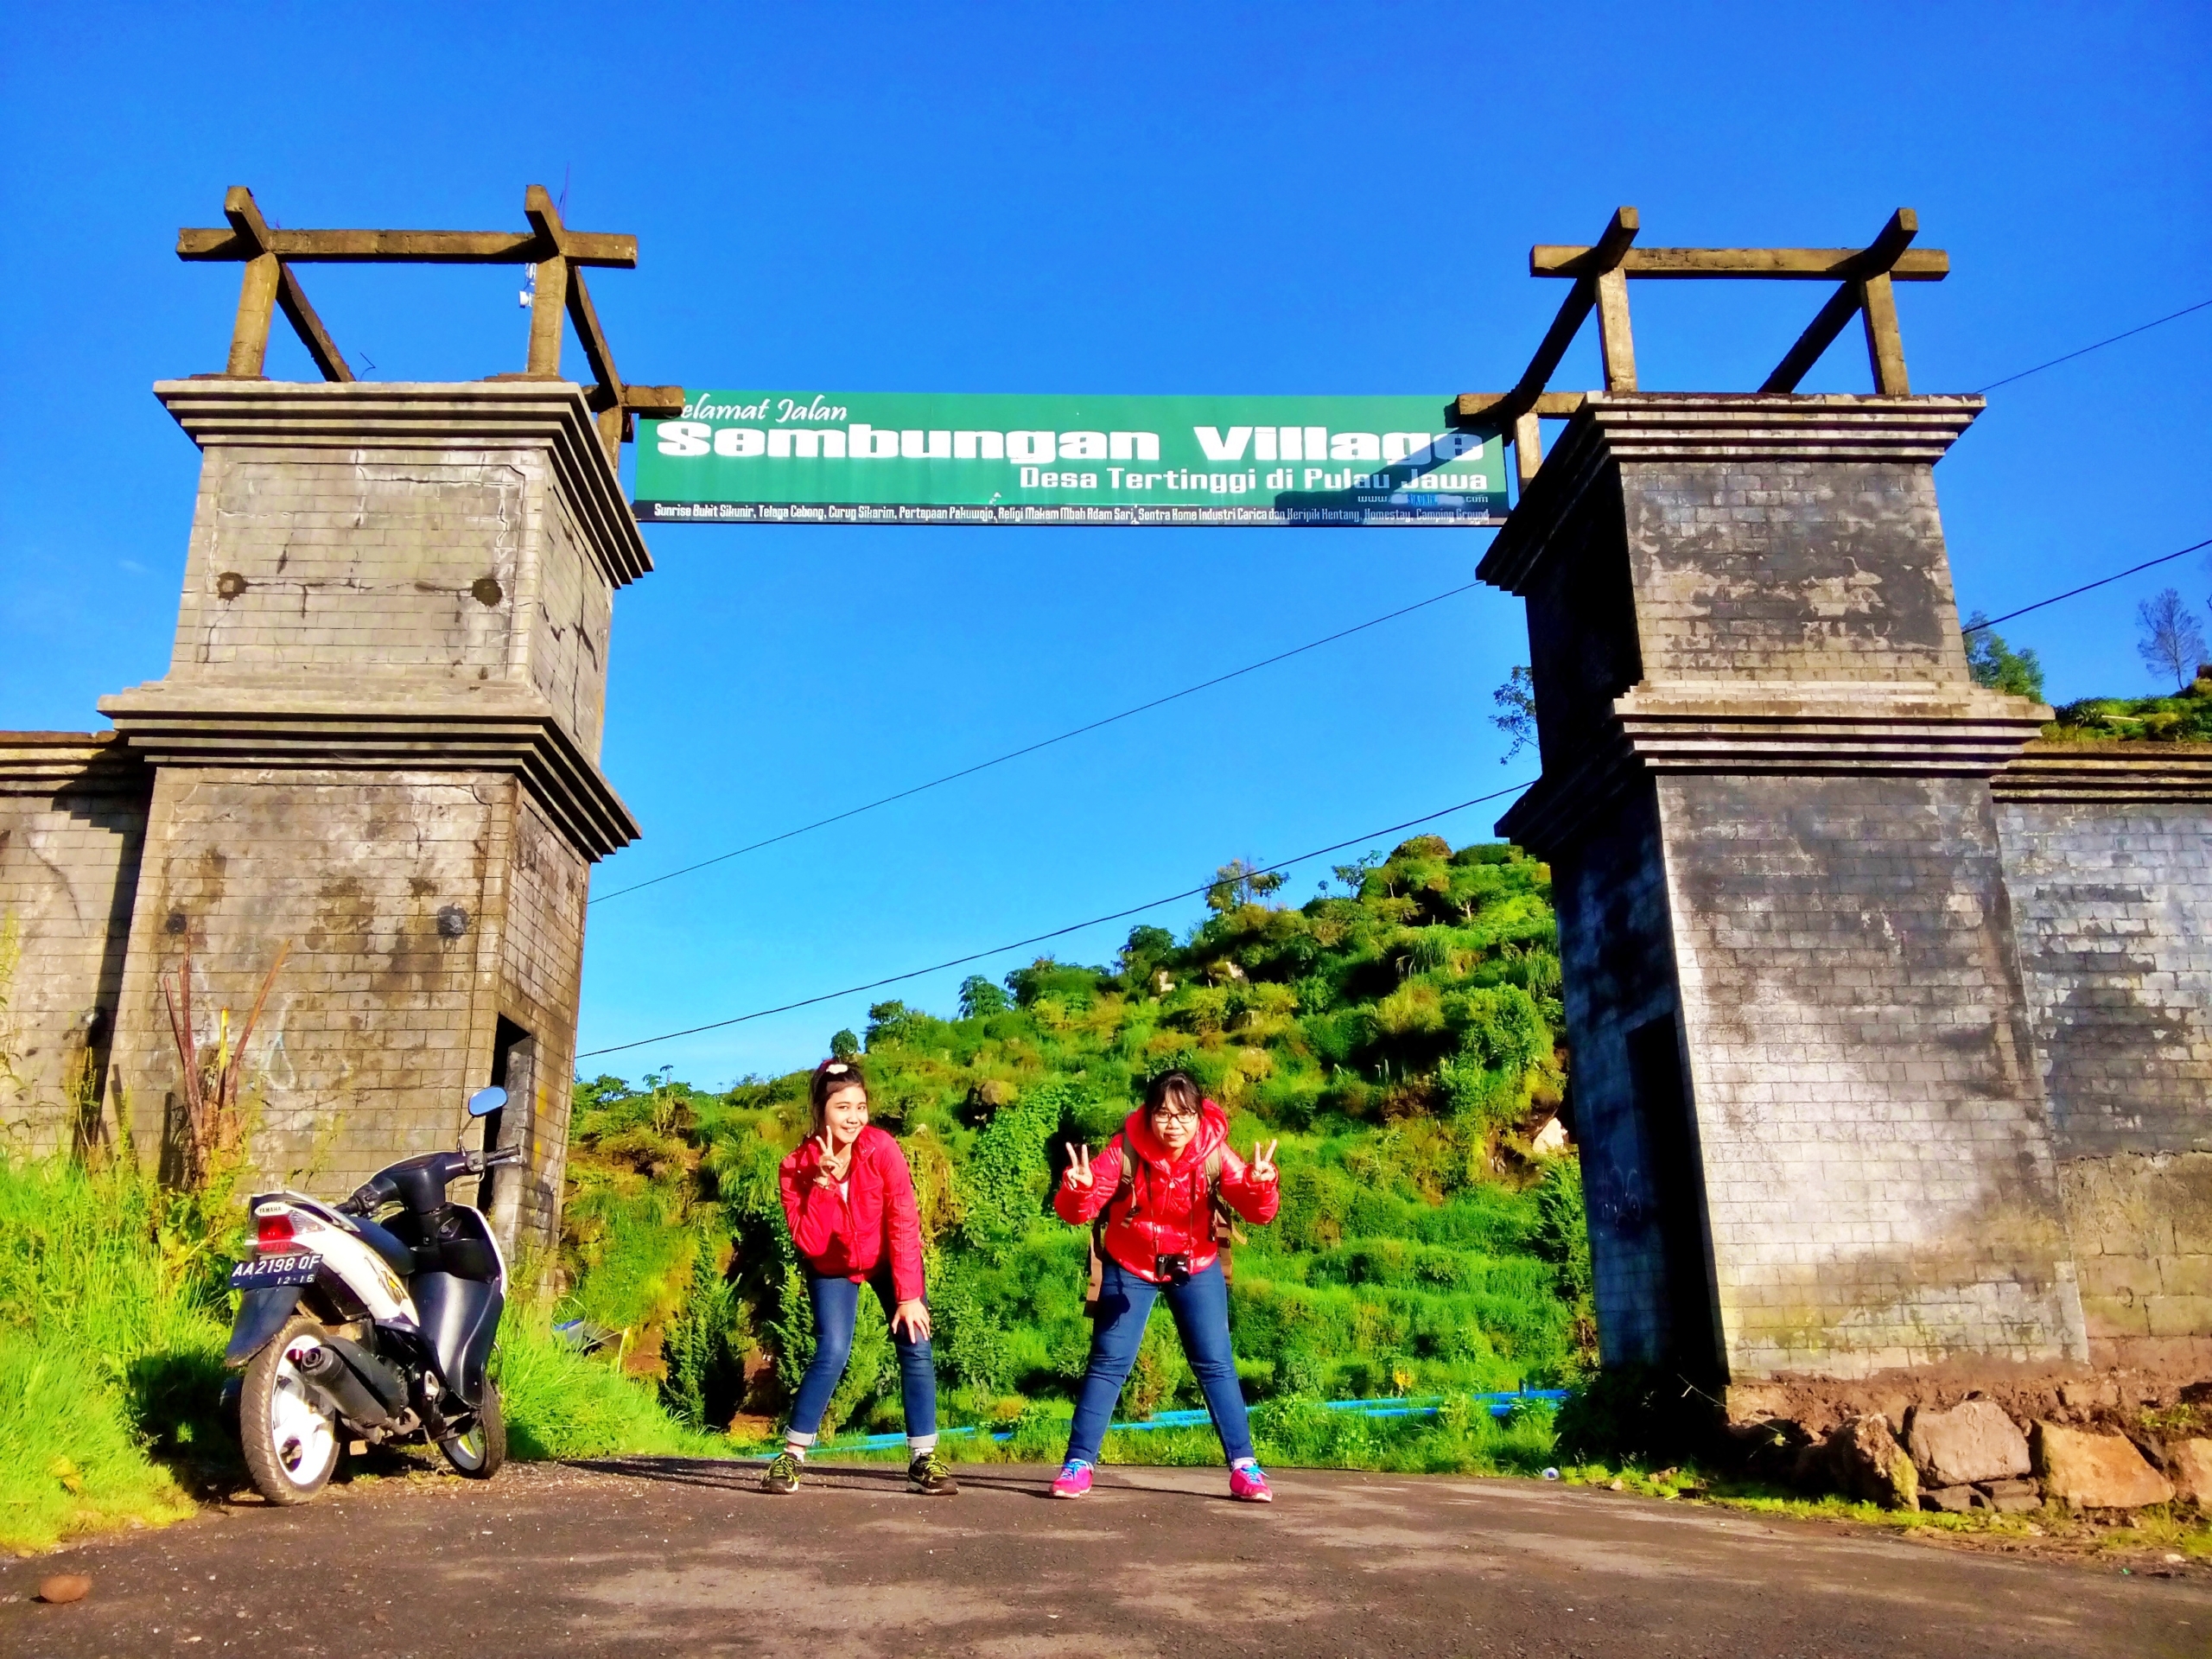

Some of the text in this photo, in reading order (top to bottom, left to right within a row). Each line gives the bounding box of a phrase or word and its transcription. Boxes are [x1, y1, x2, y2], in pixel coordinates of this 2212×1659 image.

[775, 394, 848, 423] Jalan
[657, 421, 1484, 465] Sembungan Village
[1020, 467, 1488, 493] Desa Tertinggi di Pulau Jawa
[654, 503, 691, 518] Sunrise
[693, 504, 718, 518] Bukit
[720, 505, 757, 519] Sikunir,
[759, 505, 789, 520] Telaga
[791, 505, 827, 520] Cebong,
[829, 505, 856, 521] Curug
[858, 505, 898, 520] Sikarim,
[899, 506, 948, 521] Pertapaan
[998, 507, 1023, 522] Religi
[1025, 507, 1059, 520] Makam
[1060, 507, 1086, 520] Mbah
[1087, 507, 1113, 520] Adam
[1138, 508, 1171, 521] Sentra
[1172, 508, 1197, 521] Home
[1198, 508, 1236, 521] Industri
[1237, 508, 1268, 521] Carica
[1268, 508, 1285, 521] dan
[1416, 508, 1454, 523] Camping
